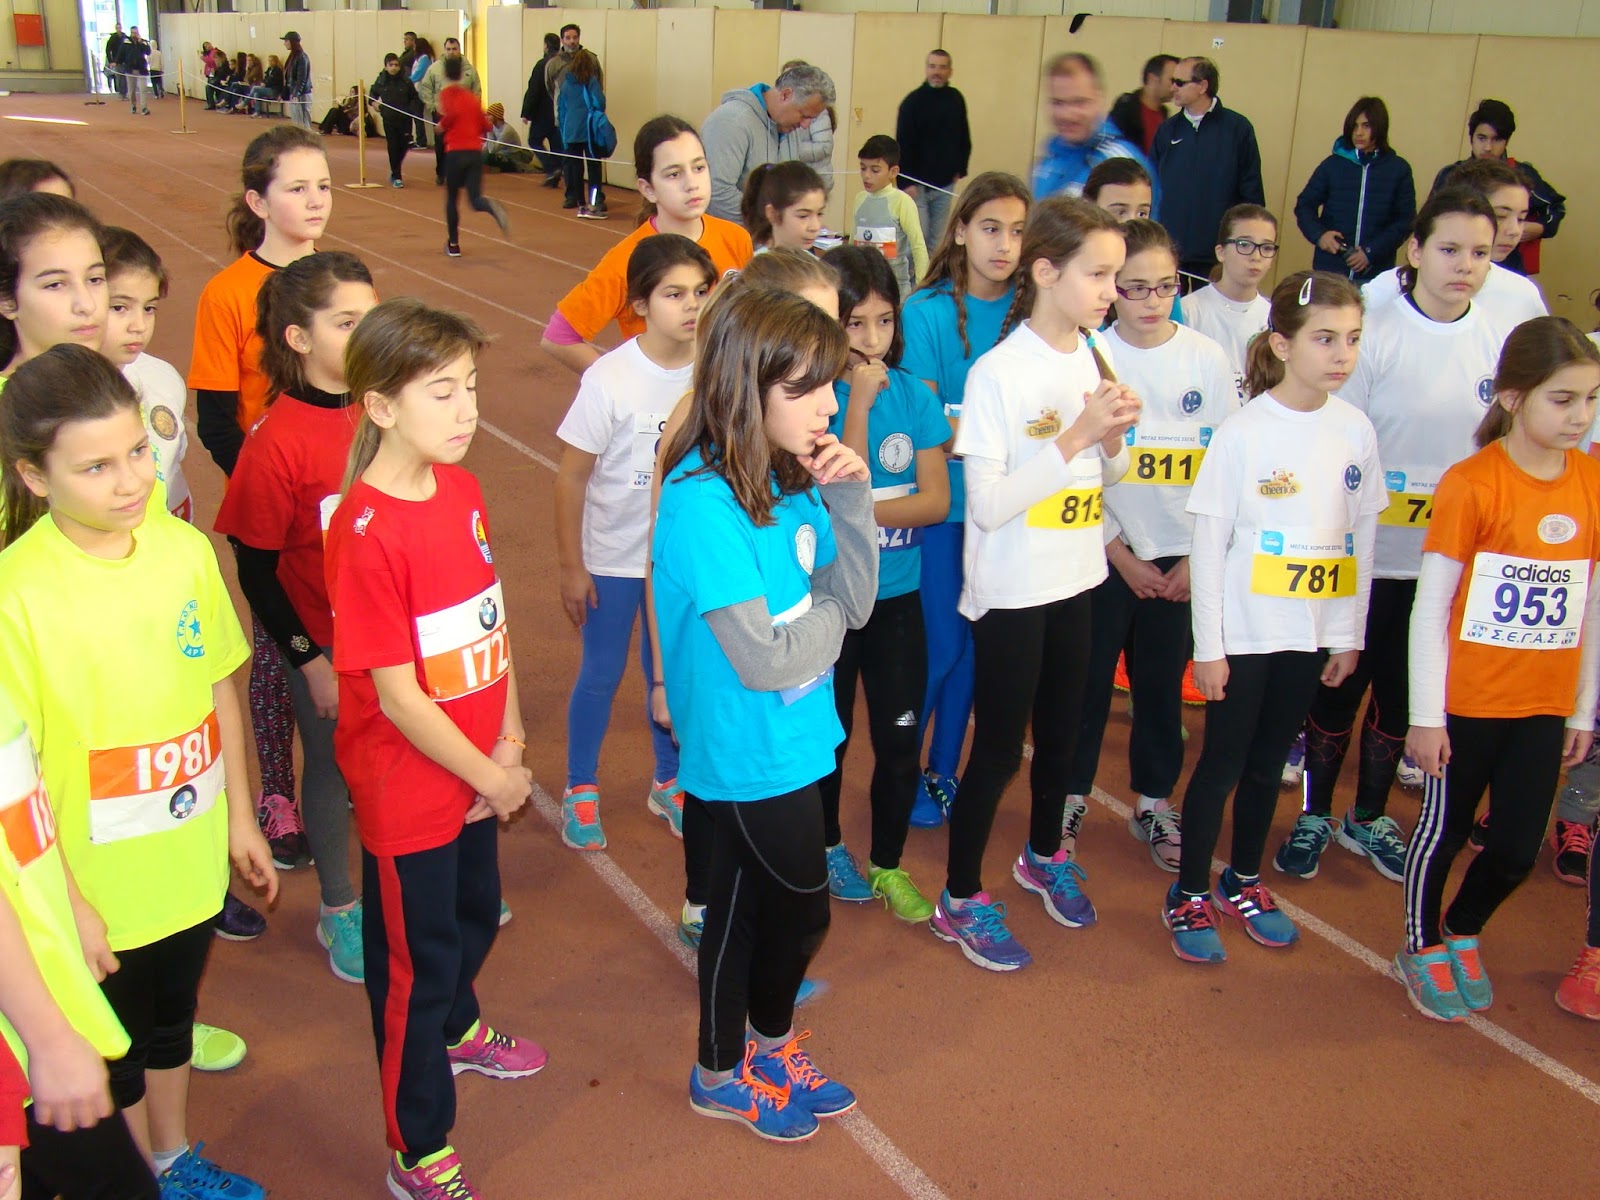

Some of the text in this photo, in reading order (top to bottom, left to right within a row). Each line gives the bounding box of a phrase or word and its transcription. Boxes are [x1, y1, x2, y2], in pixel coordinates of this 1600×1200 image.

[1137, 453, 1193, 480] 811
[1061, 491, 1103, 524] 813
[1286, 563, 1340, 593] 781
[1501, 563, 1571, 583] adidas
[1492, 582, 1568, 627] 953
[137, 723, 212, 791] 1981
